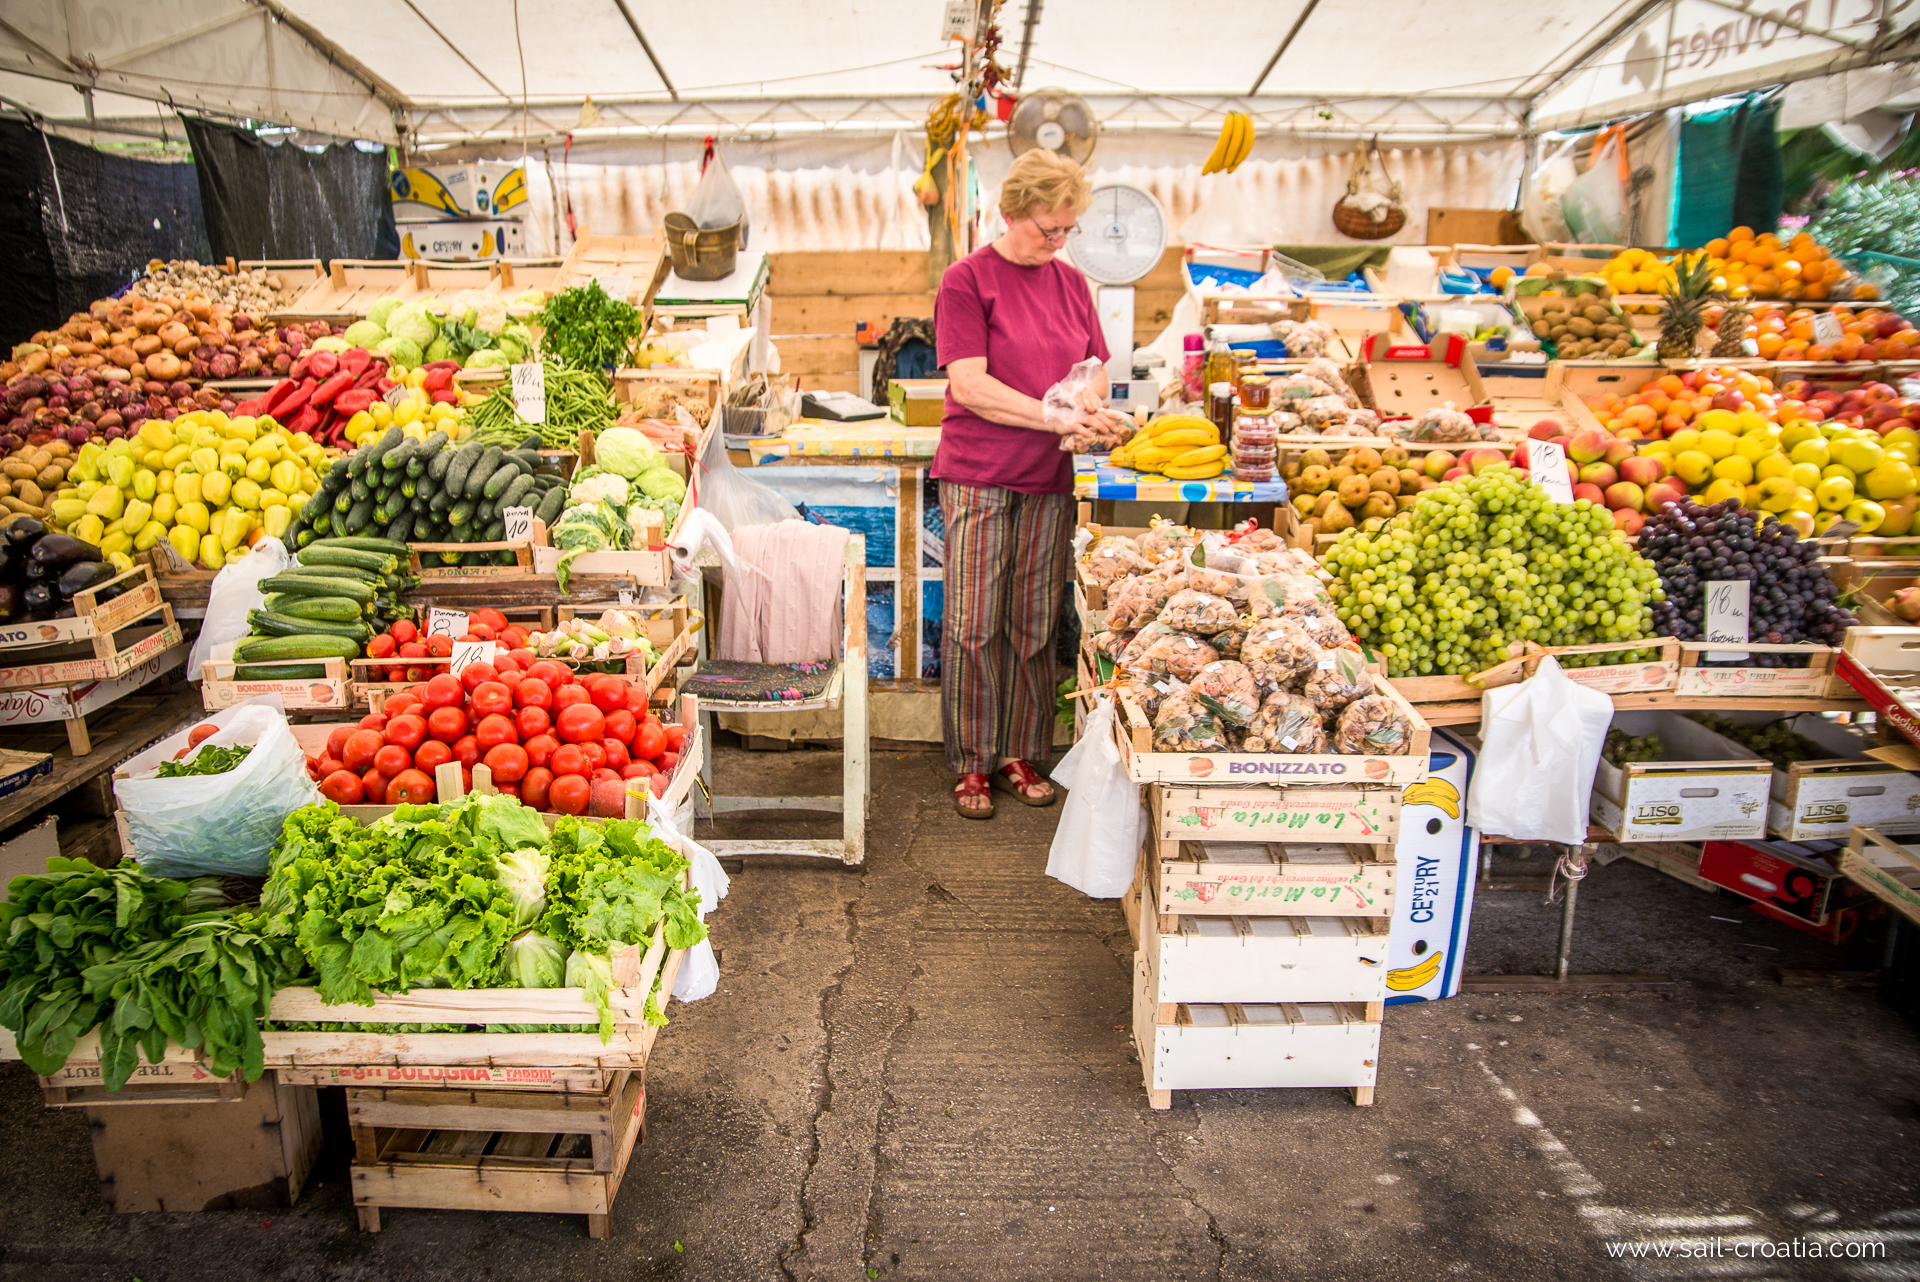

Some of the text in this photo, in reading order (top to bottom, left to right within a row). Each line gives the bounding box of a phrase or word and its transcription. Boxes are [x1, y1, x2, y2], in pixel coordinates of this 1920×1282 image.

[1532, 443, 1559, 469] 18
[508, 520, 528, 539] 10
[1708, 584, 1733, 616] 18
[133, 634, 164, 656] AGRIPAR
[1566, 668, 1617, 680] BONIZZATO
[236, 683, 284, 693] BONIZZATO
[1229, 761, 1347, 775] BONIZZATO
[1220, 799, 1353, 811] colline moreniche del Garda
[1637, 805, 1680, 818] LISO
[1806, 803, 1848, 817] LISO
[1231, 811, 1346, 829] La Merla
[1216, 874, 1248, 884] Garda
[1249, 875, 1265, 884] del
[1265, 875, 1315, 885] moreniche
[1227, 885, 1342, 903] La Merla
[1410, 855, 1441, 923] CENTURY
[1425, 881, 1440, 897] 21
[63, 1065, 174, 1079] TRE RUT
